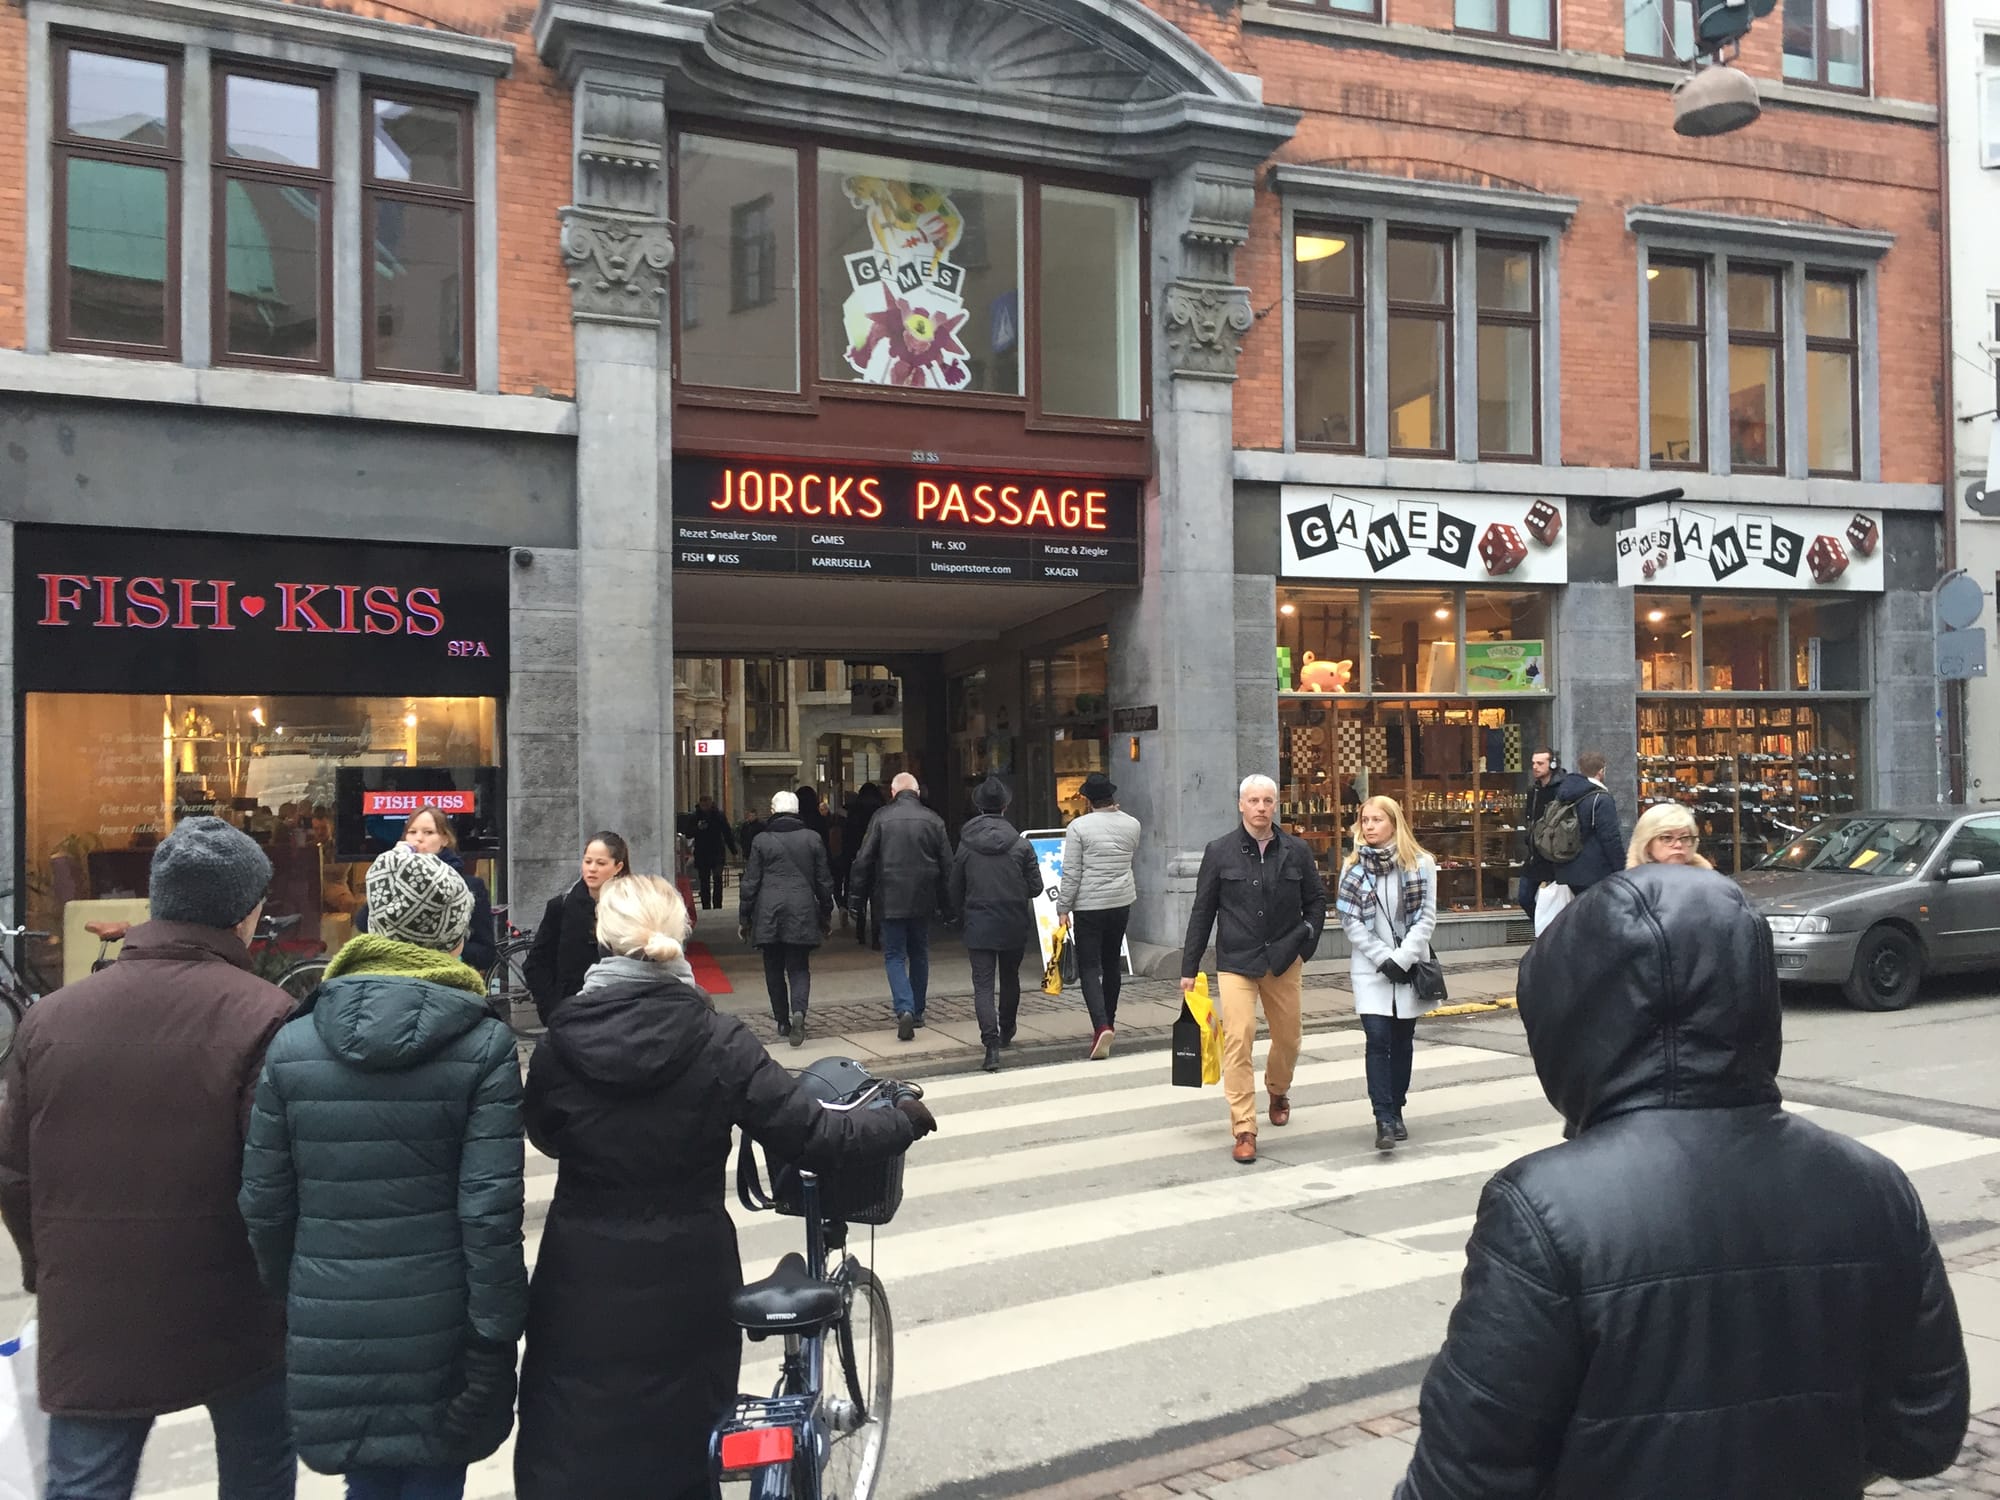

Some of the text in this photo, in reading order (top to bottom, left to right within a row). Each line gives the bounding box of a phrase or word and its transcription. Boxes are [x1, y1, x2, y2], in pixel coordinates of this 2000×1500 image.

[857, 259, 954, 289] GAMES
[710, 469, 1108, 530] JORCKS PASSAGE
[679, 528, 778, 542] Rezet Sneaker Store
[811, 534, 845, 545] GAMES
[1298, 506, 1464, 562] GAMES
[931, 540, 967, 551] Hr. SKO
[1619, 531, 1669, 556] GAMES
[1680, 516, 1796, 572] AMES
[682, 552, 740, 564] FISH KISS
[1044, 545, 1109, 557] Kranz & Ziegler
[812, 557, 872, 569] KARRUSELLA
[931, 562, 1012, 576] Unisportstore.com
[1044, 566, 1079, 577] SKAGEN
[36, 573, 446, 637] FISH KISS
[447, 640, 491, 658] SPA
[372, 795, 464, 810] FISH KISS
